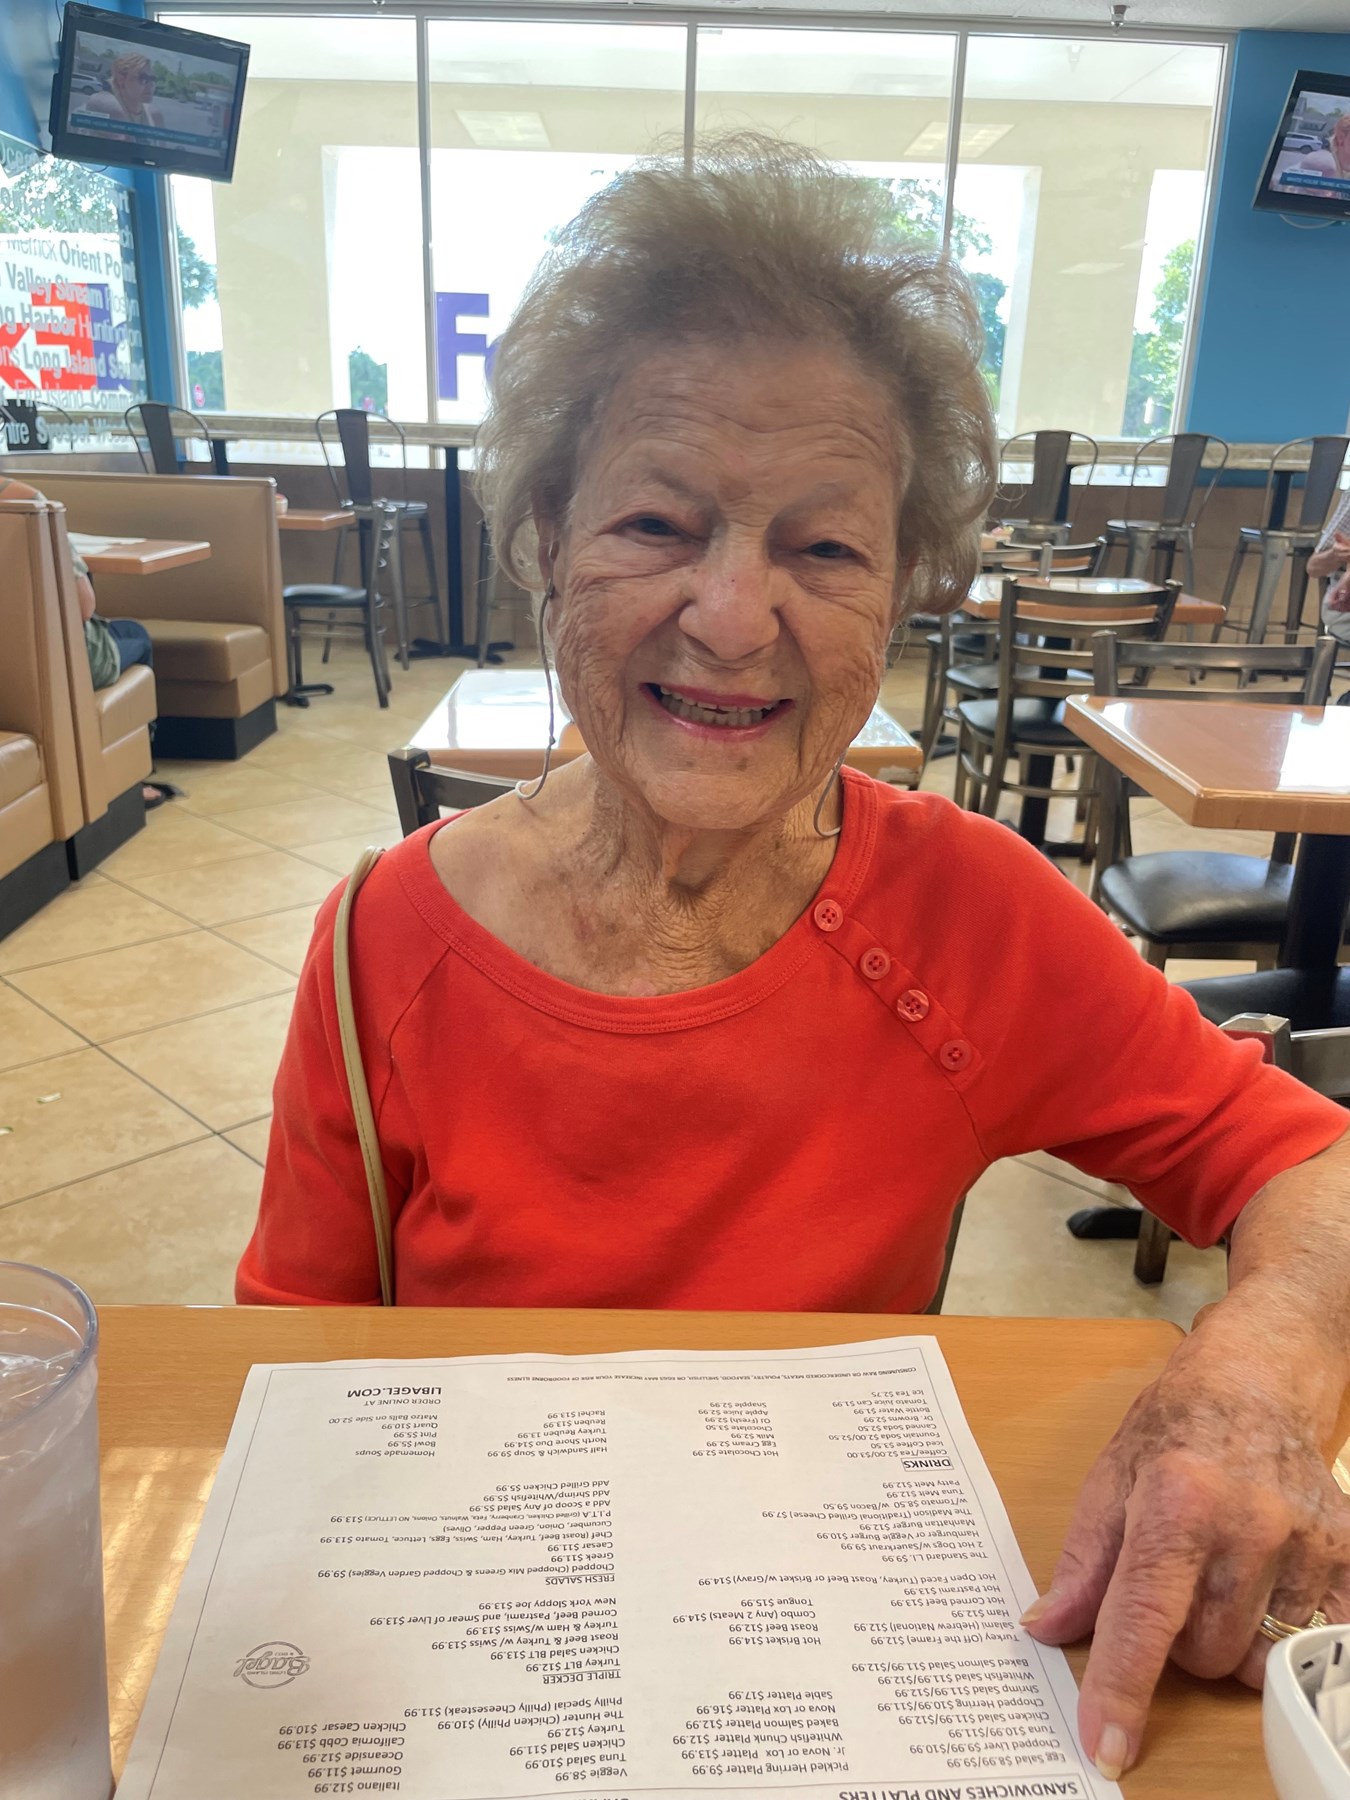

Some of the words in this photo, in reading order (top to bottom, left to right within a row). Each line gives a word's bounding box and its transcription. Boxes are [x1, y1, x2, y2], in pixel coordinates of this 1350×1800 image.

[60, 240, 102, 274] Orient
[5, 262, 52, 304] Valley
[55, 274, 104, 309] Stream
[20, 303, 76, 336] Harbor
[23, 342, 62, 379] Long
[64, 348, 106, 378] Island
[45, 381, 83, 408] Island
[347, 1386, 442, 1398] LIBAGEL.COM
[393, 1431, 418, 1439] $5.99
[828, 1433, 880, 1442] $2.00/$2.50
[870, 1441, 895, 1450] $3.50
[846, 1450, 899, 1459] $2.00/$3.00
[899, 1449, 948, 1457] Coffee/Tea
[902, 1458, 952, 1469] DRINKS
[859, 1522, 891, 1532] $12.99
[892, 1520, 924, 1529] Burger
[924, 1519, 976, 1527] Manhattan
[547, 1542, 580, 1552] $11.99
[840, 1542, 867, 1551] $9.99
[868, 1541, 932, 1552] w/Sauerkraut
[932, 1540, 957, 1550] Dogs
[550, 1553, 584, 1563] $11.99
[585, 1552, 614, 1561] Greek
[881, 1554, 909, 1563] $9.99
[909, 1553, 925, 1562] L.I.
[925, 1552, 969, 1562] Standard
[545, 1575, 583, 1586] SALADS
[584, 1574, 615, 1583] FRESH
[903, 1586, 938, 1596] $13.99
[938, 1585, 982, 1595] Pastrami
[982, 1585, 1001, 1593] Hot
[478, 1601, 513, 1610] $13.99
[515, 1601, 532, 1609] Joe
[533, 1599, 568, 1609] Sloppy
[569, 1599, 592, 1608] York
[593, 1597, 617, 1605] New
[740, 1598, 775, 1608] $15.99
[776, 1597, 814, 1607] Tongue
[890, 1598, 924, 1608] $13.99
[925, 1598, 948, 1607] Beef
[949, 1596, 986, 1607] Corned
[987, 1596, 1006, 1605] Hot
[466, 1625, 501, 1636] $13.99
[503, 1624, 545, 1634] w/Swiss
[546, 1624, 570, 1632] Ham
[572, 1623, 582, 1632] &
[583, 1621, 618, 1630] Turkey
[853, 1622, 888, 1633] $12.99
[889, 1622, 936, 1633] National)
[937, 1620, 980, 1631] (Hebrew
[981, 1622, 1015, 1630] Salami
[728, 1636, 764, 1646] $14.99
[766, 1636, 801, 1645] Brisket
[802, 1636, 822, 1645] Hot
[870, 1635, 905, 1646] $12.99
[906, 1635, 943, 1646] Frame)
[944, 1635, 962, 1644] the
[963, 1632, 983, 1644] (Off
[985, 1632, 1020, 1642] Turkey
[233, 1651, 311, 1677] Bagel
[851, 1661, 927, 1673] $11.99/$12.99
[927, 1661, 956, 1671] Salad
[956, 1659, 996, 1668] Salmon
[997, 1658, 1030, 1668] Baked
[542, 1673, 584, 1685] DECKER
[587, 1670, 622, 1681] TRIPLE
[728, 1690, 765, 1701] $17.99
[766, 1691, 802, 1701] Platter
[804, 1690, 833, 1700] Sable
[518, 1701, 552, 1713] (Philly
[554, 1698, 592, 1711] Special
[593, 1696, 623, 1707] Philly
[877, 1700, 954, 1712] $10.99/$11.99
[956, 1698, 996, 1709] Herring
[996, 1697, 1044, 1709] Chopped
[404, 1707, 442, 1718] $11.99
[444, 1704, 516, 1717] Cheesesteak)
[948, 1726, 1027, 1739] $10.99/$11.99
[1027, 1725, 1056, 1734] Tuna
[672, 1734, 710, 1745] $12.99
[714, 1734, 751, 1744] Platter
[753, 1734, 788, 1744] Chunk
[790, 1732, 843, 1744] Whitefish
[909, 1741, 982, 1755] $9.99/$10.99
[983, 1741, 1010, 1752] Liver
[1011, 1738, 1061, 1751] Chopped
[302, 1751, 342, 1763] $12.99
[344, 1751, 404, 1762] Oceanside
[946, 1755, 1013, 1768] $8.99/$9.99
[1014, 1754, 1045, 1766] Salad
[1044, 1751, 1066, 1763] Egg
[307, 1766, 347, 1778] $11.99
[350, 1766, 402, 1776] Gourmet
[589, 1766, 628, 1779] Veggie
[692, 1764, 724, 1776] $9.99
[726, 1764, 764, 1775] Platter
[765, 1762, 808, 1774] Herring
[810, 1762, 849, 1773] Pickled
[555, 1769, 587, 1782] $8.99
[314, 1781, 354, 1794] $12.99
[357, 1781, 400, 1792] Italiano
[965, 1782, 1078, 1800] SANDWICHES
[838, 1789, 920, 1800] PLATTERS
[924, 1788, 962, 1800] AND
